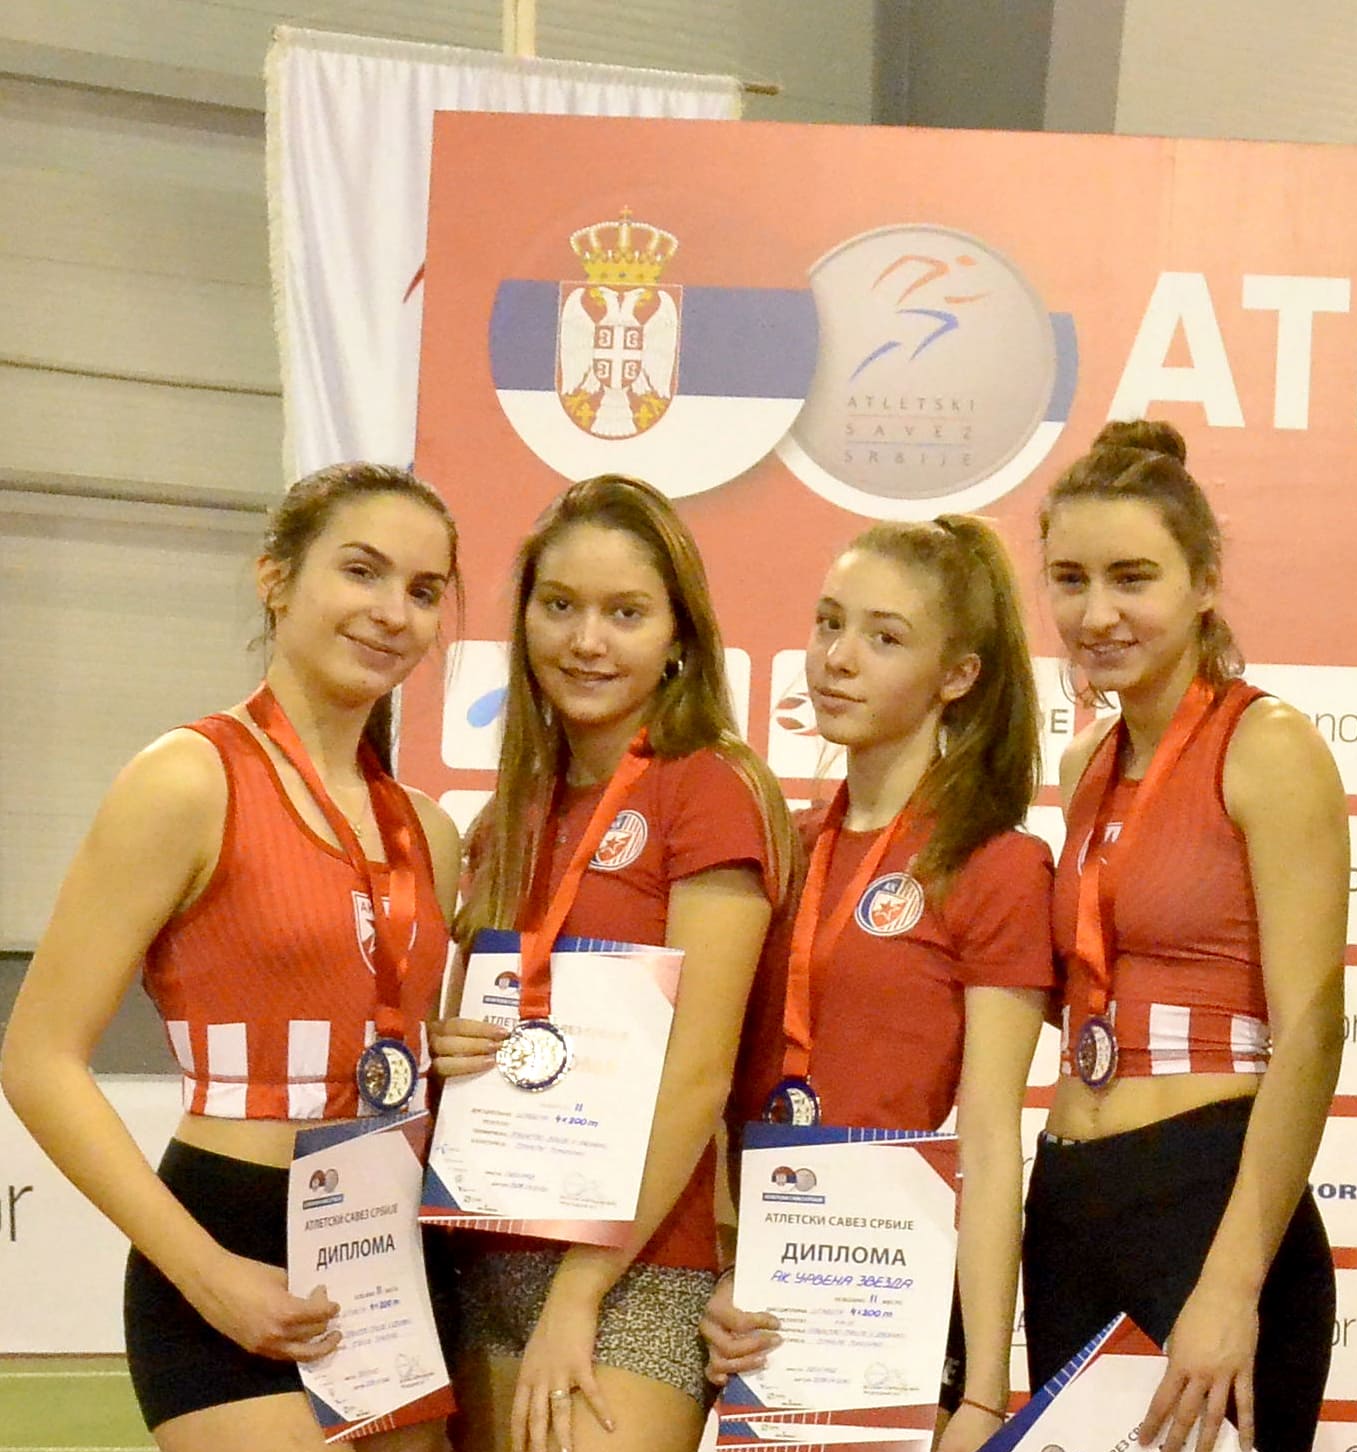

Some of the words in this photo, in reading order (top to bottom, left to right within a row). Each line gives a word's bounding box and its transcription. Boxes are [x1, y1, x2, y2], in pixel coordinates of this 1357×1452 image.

[847, 395, 975, 412] ATLETSKI
[845, 424, 973, 441] SAVEZ
[843, 450, 972, 468] SRBIJE
[765, 1213, 826, 1226] АТЛЕТСКИ
[829, 1216, 867, 1228] САВЕЗ
[870, 1219, 915, 1230] СРБИЈЕ
[316, 1234, 396, 1271] ДИПЛОМА
[781, 1242, 907, 1266] ДИПЛОМА
